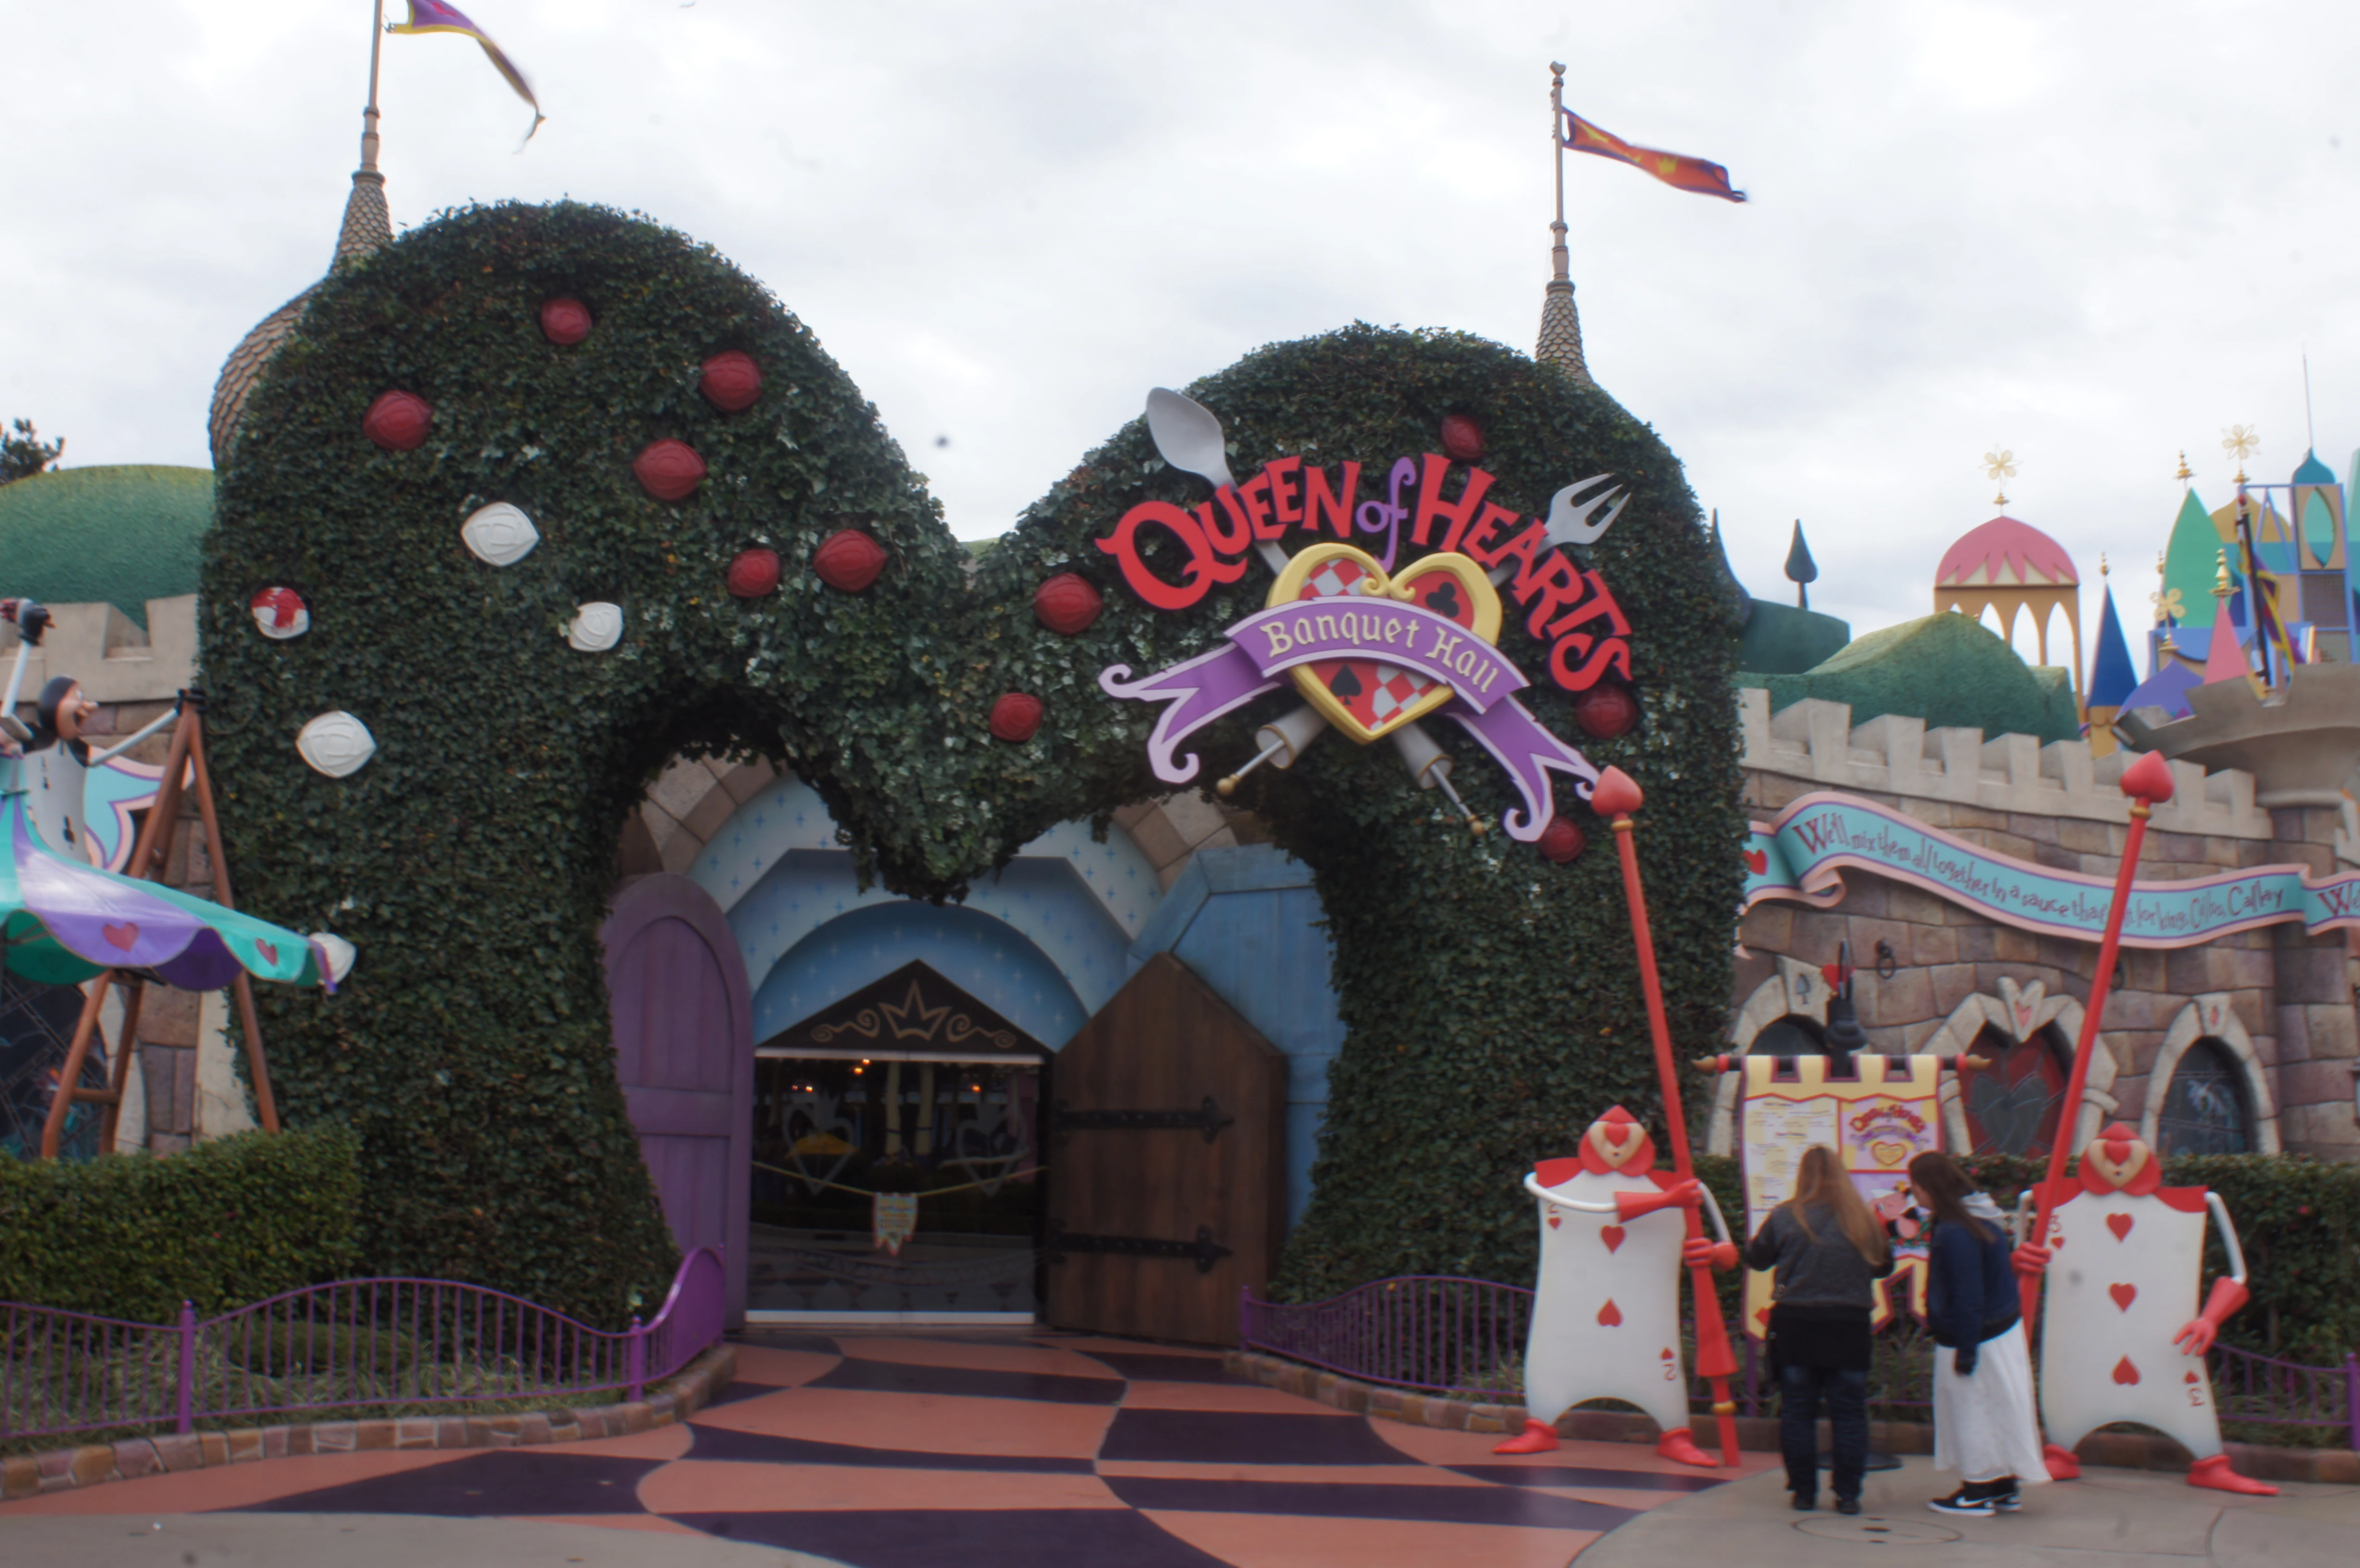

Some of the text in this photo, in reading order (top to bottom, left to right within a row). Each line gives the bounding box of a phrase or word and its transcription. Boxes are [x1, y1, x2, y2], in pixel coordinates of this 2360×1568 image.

[1095, 453, 1634, 692] QUEEN of HEARTS
[1259, 612, 1500, 695] Banquet Hall
[1851, 831, 1876, 852] mix
[1877, 825, 1911, 861] them
[1912, 837, 1932, 873] all
[1932, 851, 1990, 896] together
[1991, 877, 2007, 902] in
[2009, 884, 2020, 898] a
[2021, 893, 2070, 917] sauce
